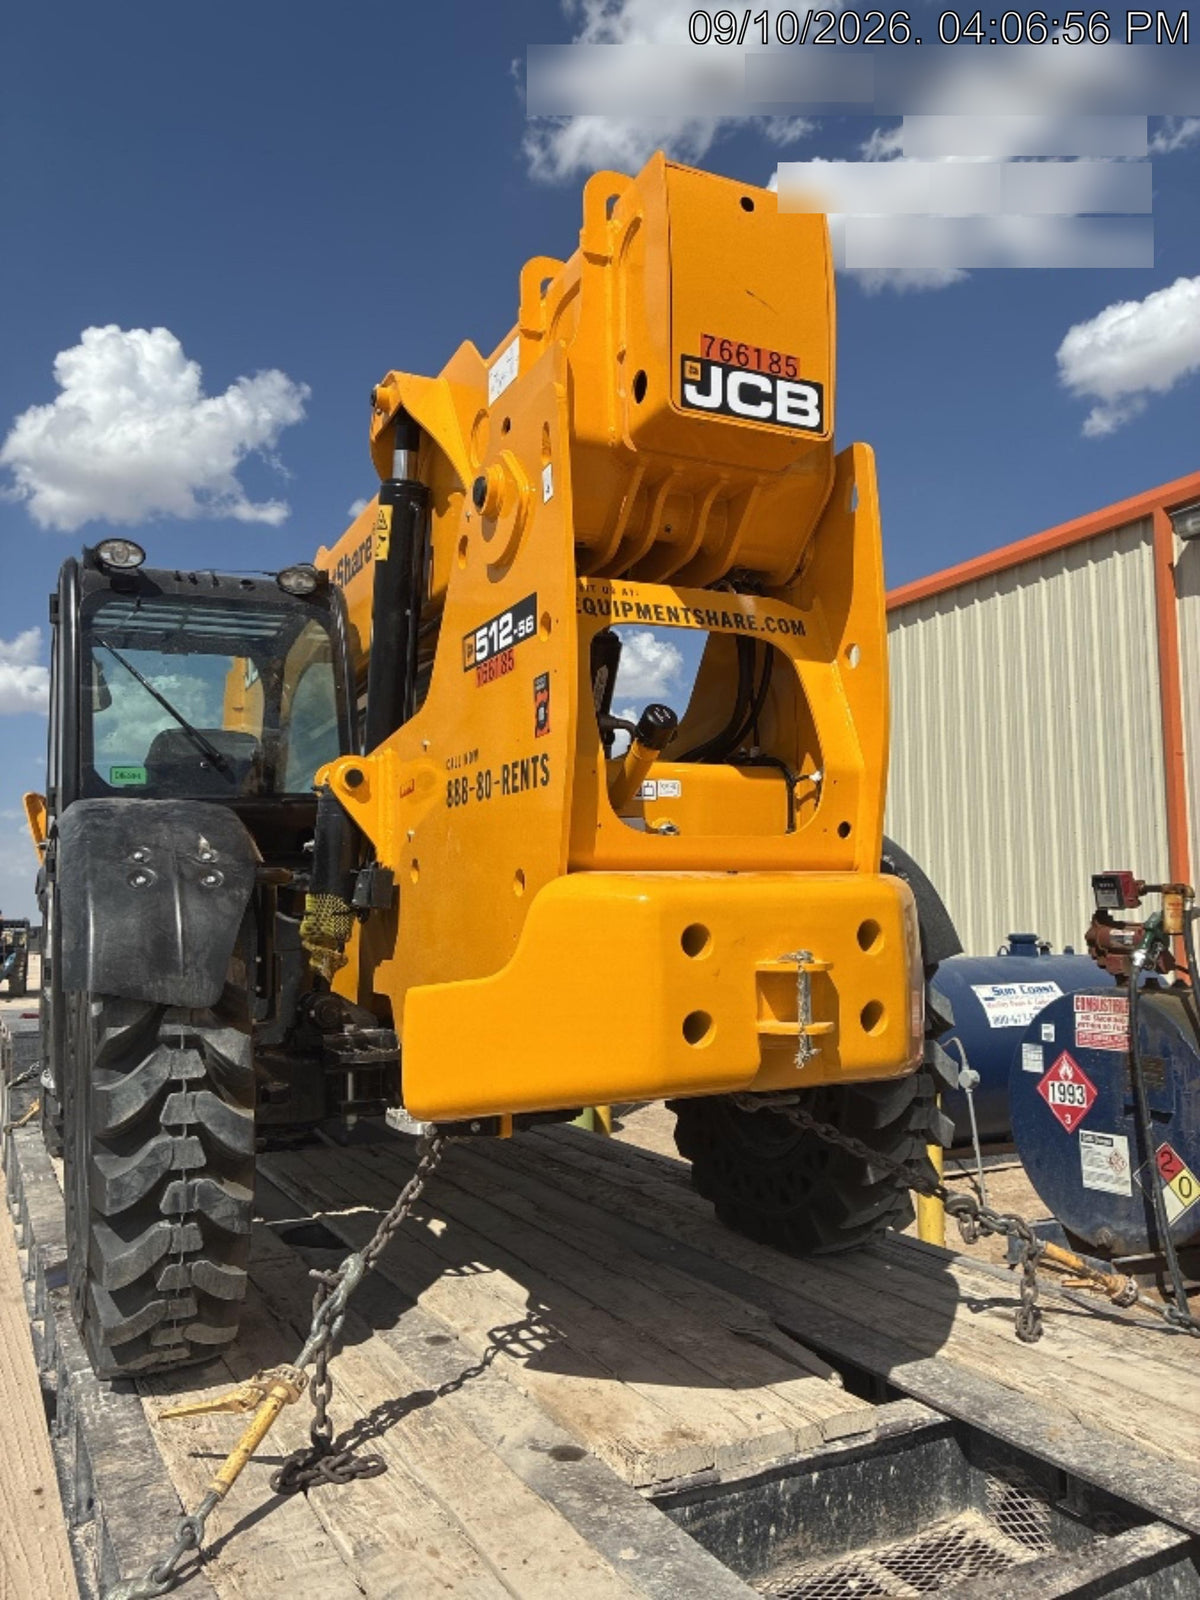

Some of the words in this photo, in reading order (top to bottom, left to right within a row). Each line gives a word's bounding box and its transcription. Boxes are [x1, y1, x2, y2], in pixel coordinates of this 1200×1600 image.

[703, 334, 798, 377] 766185
[684, 366, 821, 427] JCB
[475, 612, 535, 662] 512-56
[446, 752, 550, 809] 888-80-RENTS
[1050, 1082, 1086, 1106] 1993
[1064, 1113, 1072, 1125] 3
[1160, 1150, 1174, 1173] 2
[1179, 1176, 1193, 1199] 0
